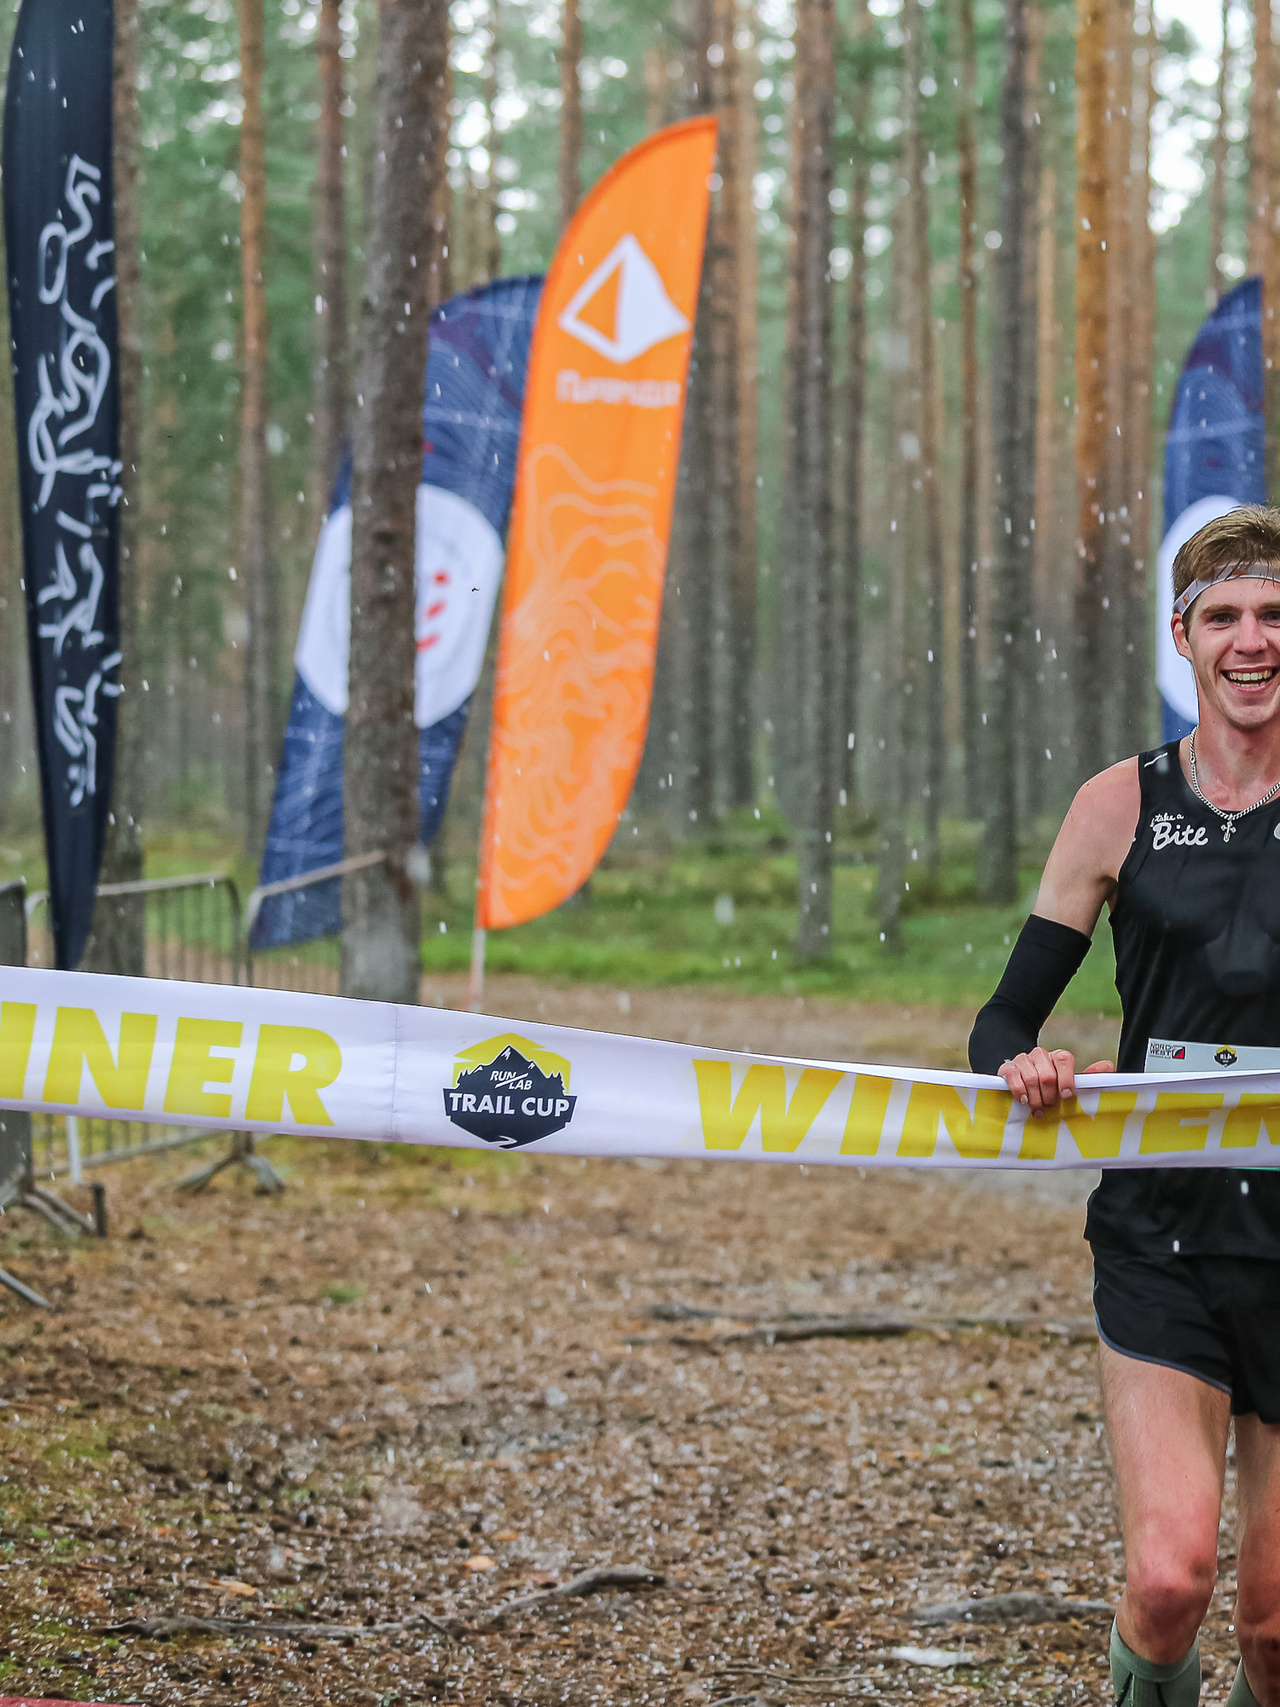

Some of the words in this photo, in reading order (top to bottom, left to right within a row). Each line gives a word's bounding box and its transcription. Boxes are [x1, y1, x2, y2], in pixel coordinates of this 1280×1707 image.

[1152, 822, 1209, 851] Bite
[490, 1070, 518, 1081] RUN
[508, 1079, 533, 1091] LAB
[449, 1092, 516, 1115] TRAIL
[521, 1096, 571, 1117] CUP
